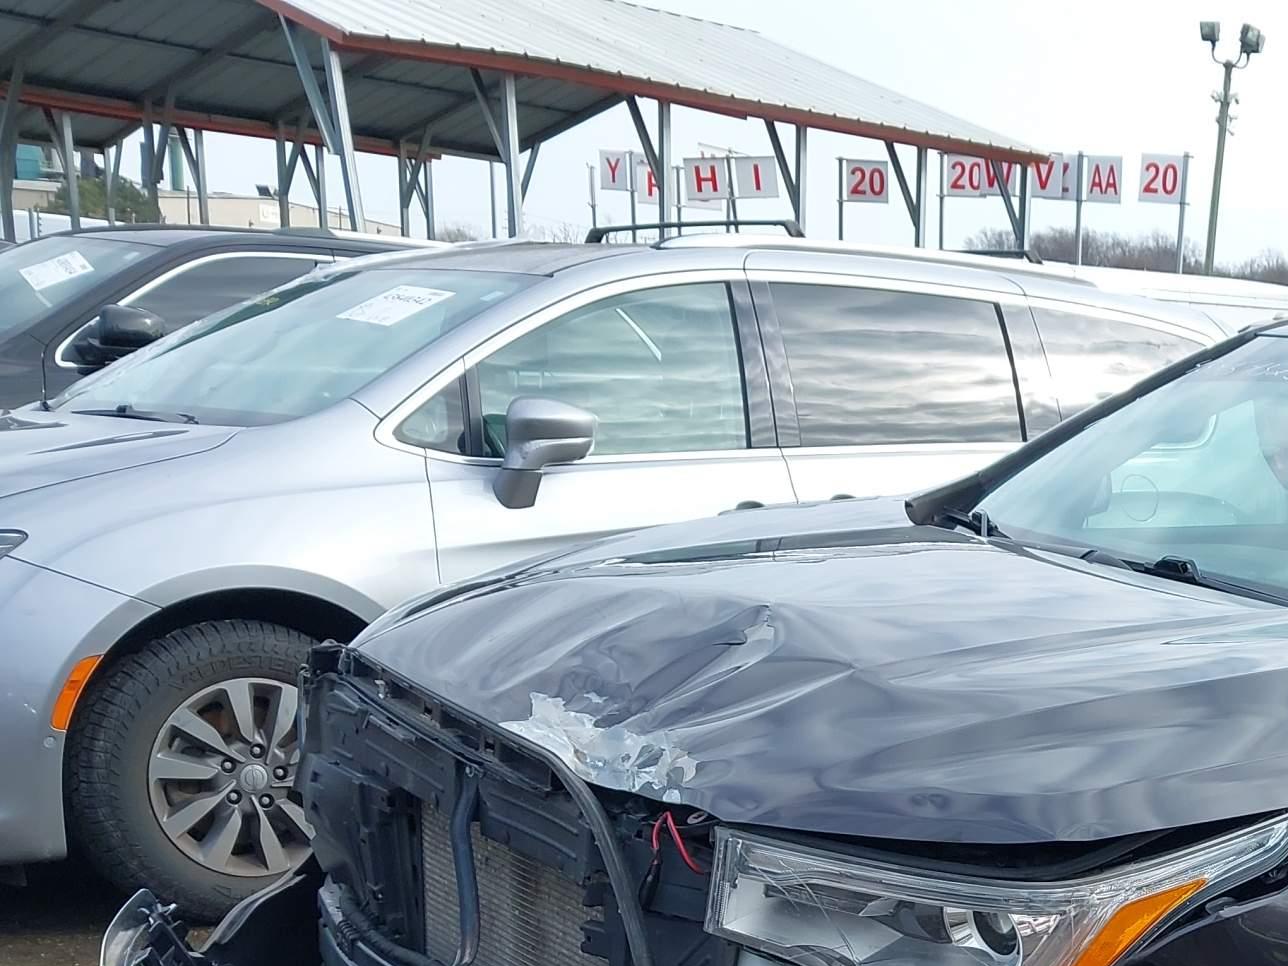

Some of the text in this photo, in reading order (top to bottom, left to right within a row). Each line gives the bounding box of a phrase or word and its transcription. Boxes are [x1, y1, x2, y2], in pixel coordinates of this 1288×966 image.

[605, 156, 621, 184] Y
[693, 164, 719, 194] H
[752, 163, 763, 193] I
[849, 166, 885, 196] 20
[950, 160, 982, 191] 20
[1034, 160, 1054, 191] V
[1089, 163, 1119, 196] AA
[1142, 163, 1178, 196] 20
